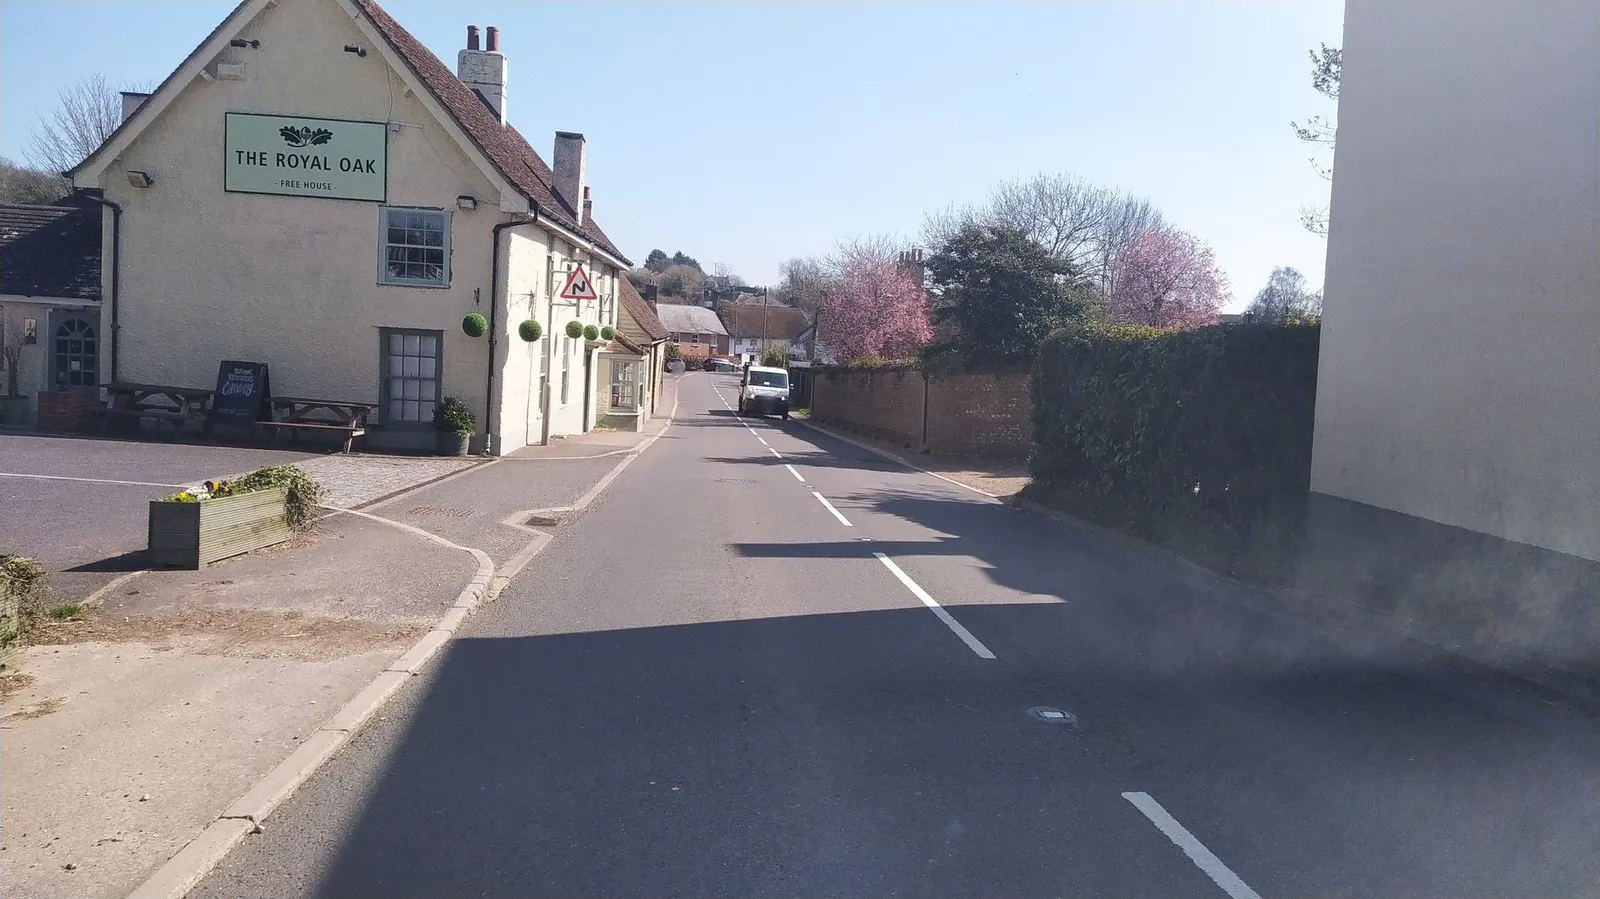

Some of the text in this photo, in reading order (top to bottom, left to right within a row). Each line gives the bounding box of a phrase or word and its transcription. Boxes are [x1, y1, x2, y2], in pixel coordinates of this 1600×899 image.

[235, 150, 376, 174] THE ROYAL OAK
[280, 179, 332, 190] FREE HOUSE
